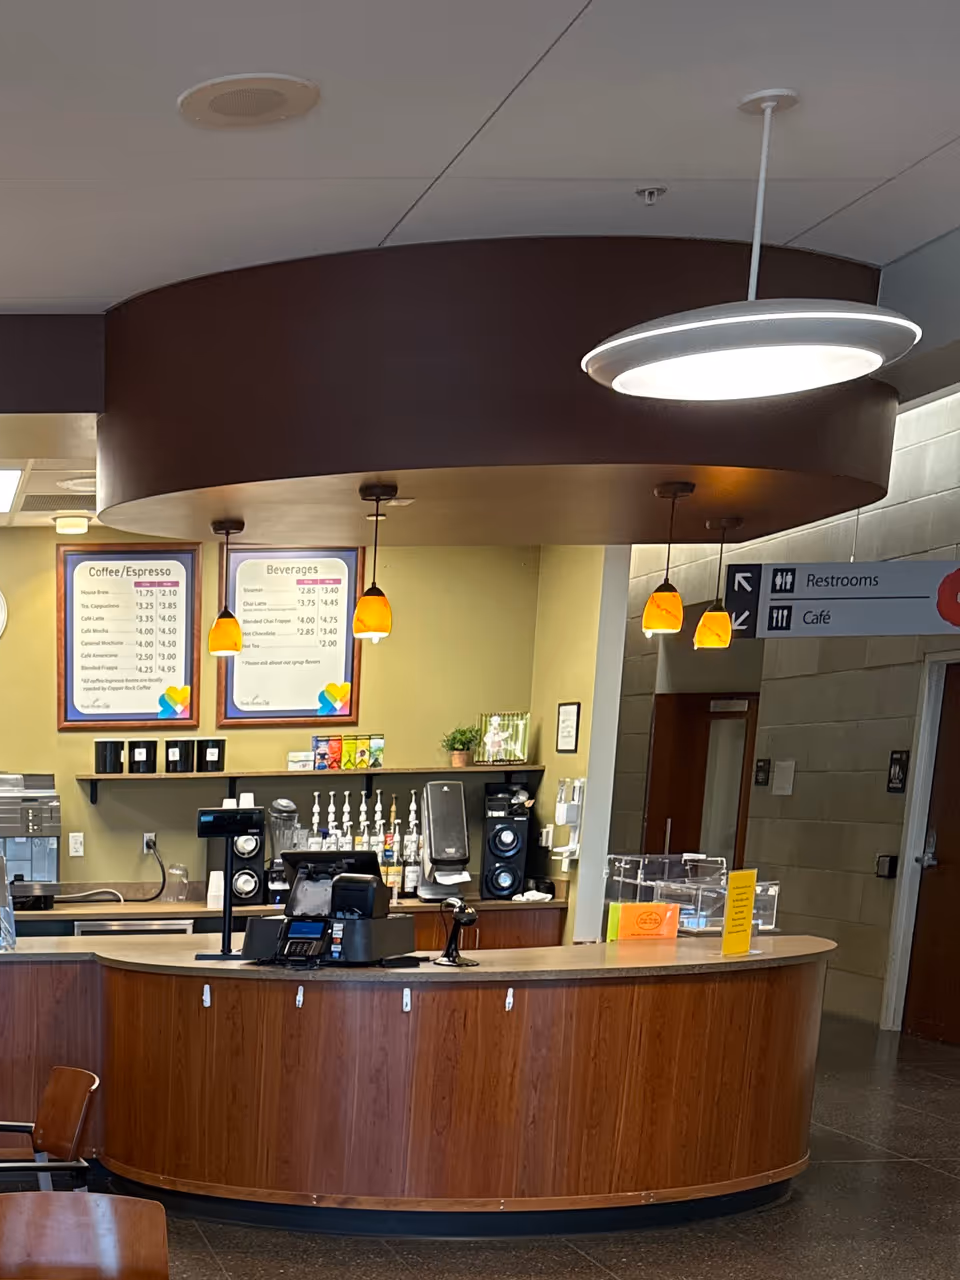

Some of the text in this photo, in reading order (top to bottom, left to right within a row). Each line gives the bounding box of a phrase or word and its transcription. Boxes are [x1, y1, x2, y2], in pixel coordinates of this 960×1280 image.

[88, 565, 172, 579] Coffee/Espresso
[266, 564, 319, 577] Beverages
[806, 573, 879, 588] Restrooms
[136, 589, 154, 597] $1.75
[159, 589, 178, 597] $2.10
[298, 587, 316, 595] $2.85
[321, 586, 339, 594] $3.40
[136, 601, 154, 610] $3.25
[159, 601, 177, 609] $3.85
[297, 599, 316, 607] $3.75
[320, 598, 339, 606] $4.45
[136, 615, 154, 623] $3.35
[297, 616, 316, 624] $4.00
[320, 616, 338, 624] $4.75
[802, 610, 831, 625] Café
[136, 627, 154, 635] $4.00
[158, 627, 177, 635] $4.50
[297, 628, 315, 636] $2.85
[319, 627, 338, 635] $3.40
[136, 640, 154, 648] $4.00
[158, 640, 177, 648] $4.50
[319, 639, 338, 647] $2.00
[136, 652, 154, 661] $2.50
[136, 665, 154, 673] $4.25
[158, 665, 176, 673] $4.95
